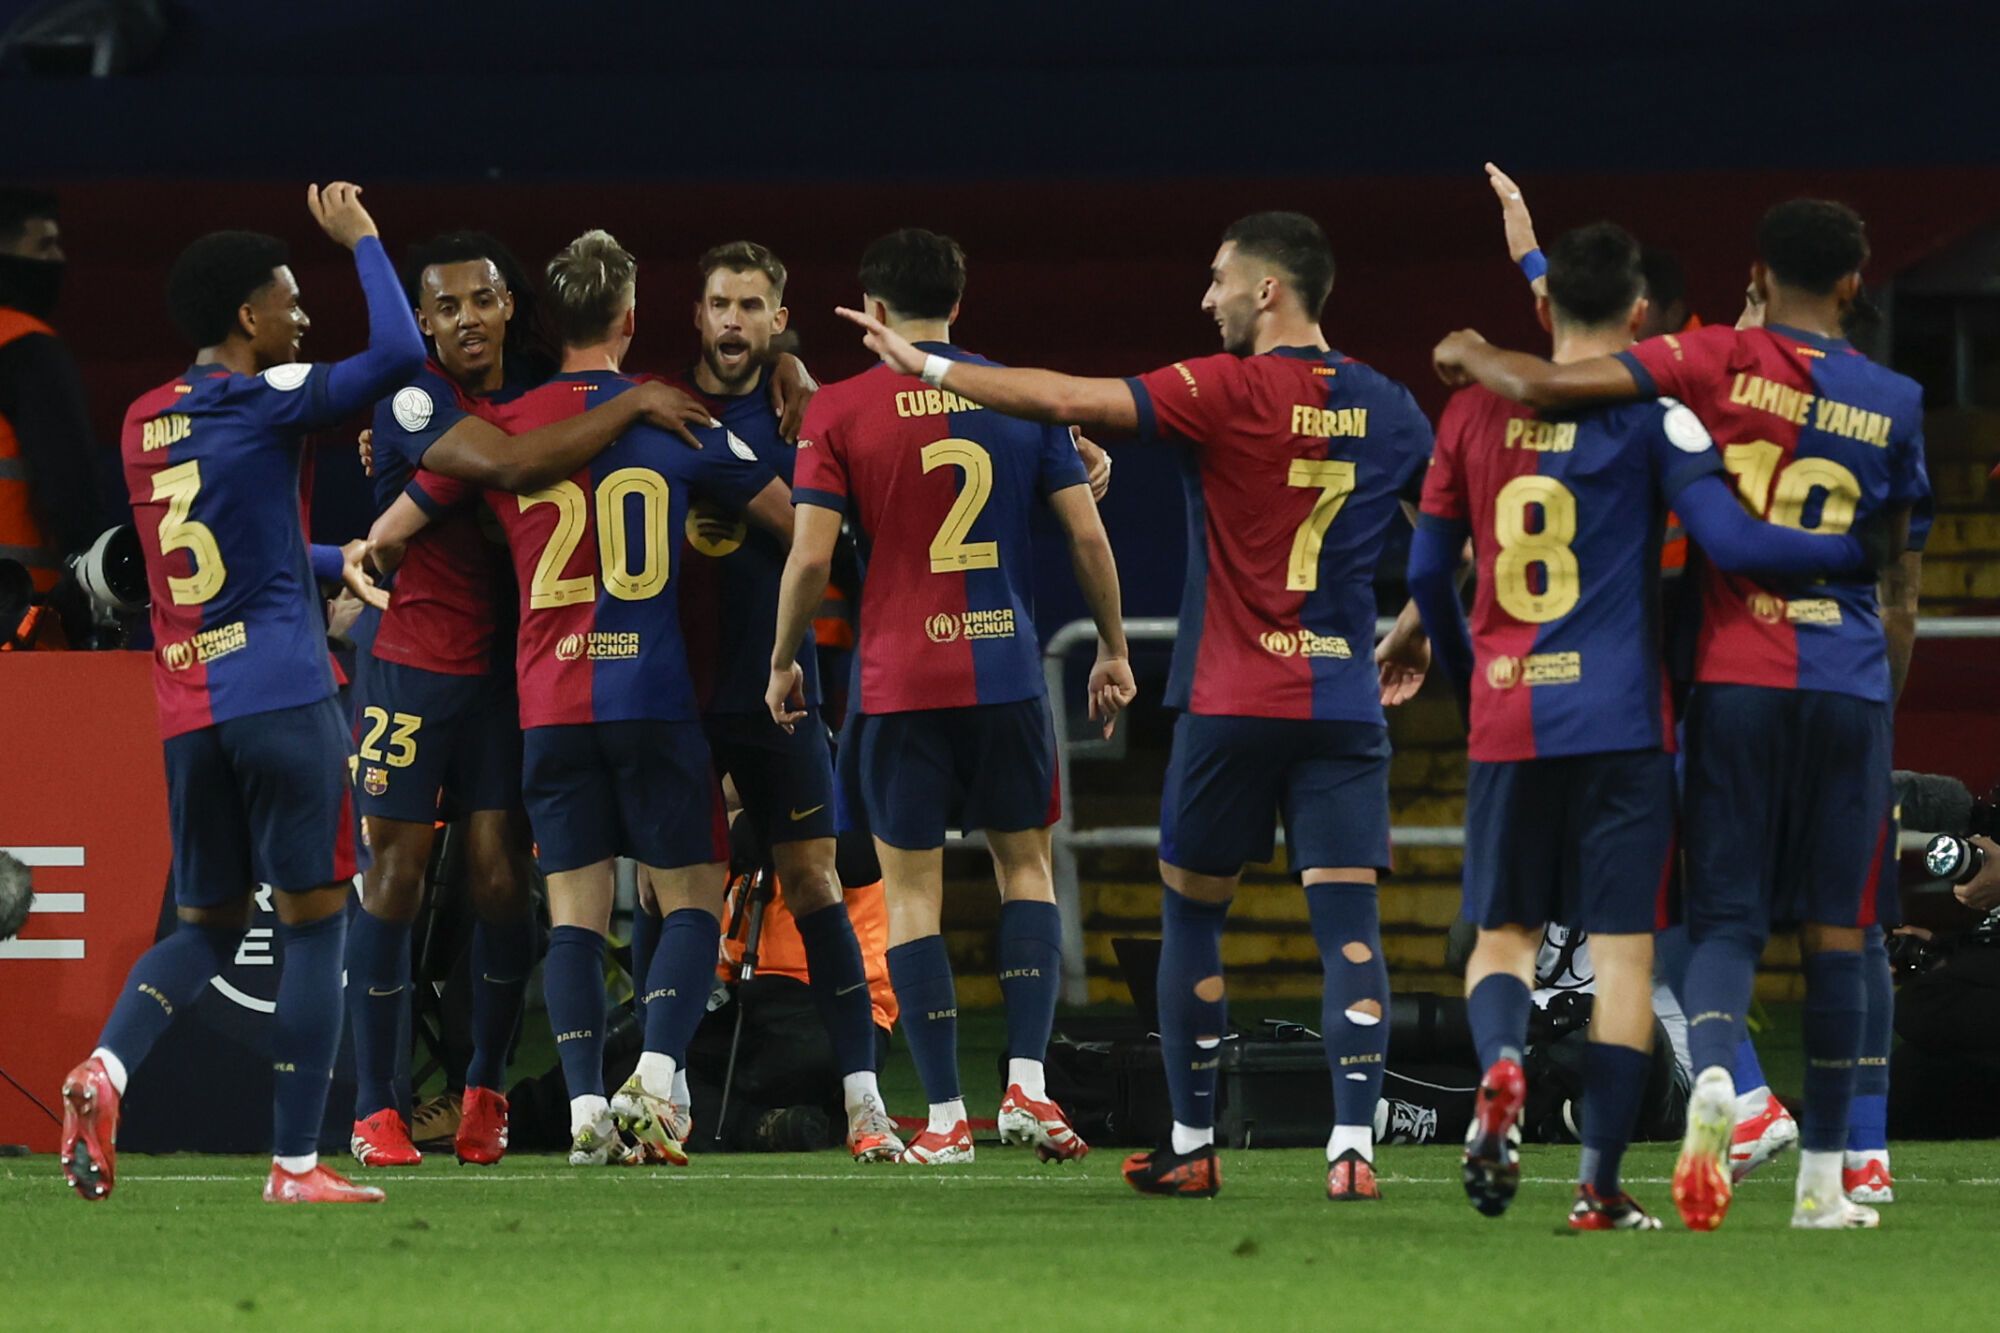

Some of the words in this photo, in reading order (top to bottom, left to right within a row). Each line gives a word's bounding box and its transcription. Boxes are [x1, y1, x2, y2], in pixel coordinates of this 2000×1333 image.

[896, 389, 984, 417] CUBAR
[1291, 405, 1367, 438] FERRAN
[1505, 418, 1577, 453] PEDRI
[1815, 398, 1892, 448] YAMAL
[920, 438, 999, 573] 2
[150, 459, 227, 606] 3
[517, 467, 670, 610] 20
[1286, 458, 1355, 591] 7
[1495, 475, 1580, 623] 8
[962, 609, 1014, 624] UNHCR
[963, 621, 1015, 635] ACNUR
[191, 622, 244, 648] UNHCR
[197, 632, 246, 661] ACNUR
[586, 644, 639, 655] ACNUR
[587, 633, 639, 644] UNHCR
[360, 706, 422, 768] 23
